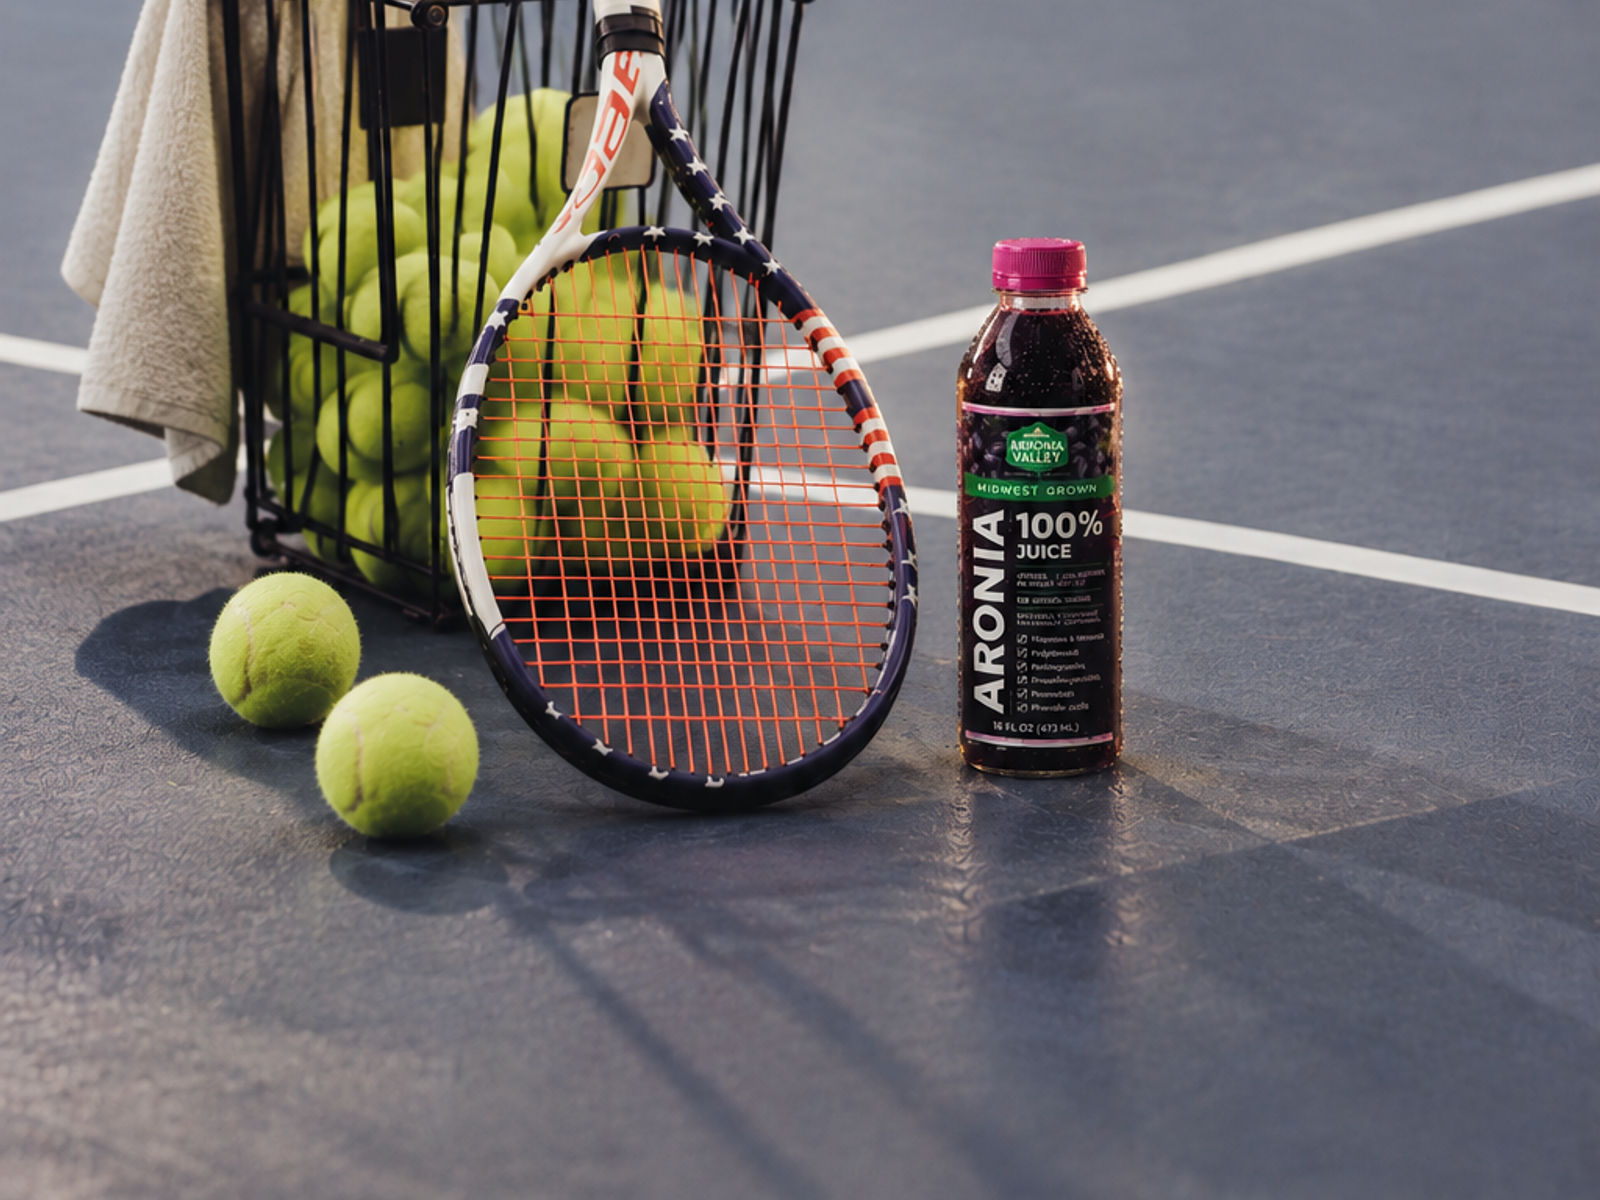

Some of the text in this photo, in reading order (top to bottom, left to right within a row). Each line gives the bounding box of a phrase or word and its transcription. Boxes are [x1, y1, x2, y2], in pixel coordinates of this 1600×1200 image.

[1012, 451, 1061, 463] VALLEY
[977, 482, 1097, 496] MIDWEST GROWN
[1015, 510, 1103, 539] 100%
[1016, 543, 1072, 559] JUICE
[972, 509, 1005, 715] ARONIA
